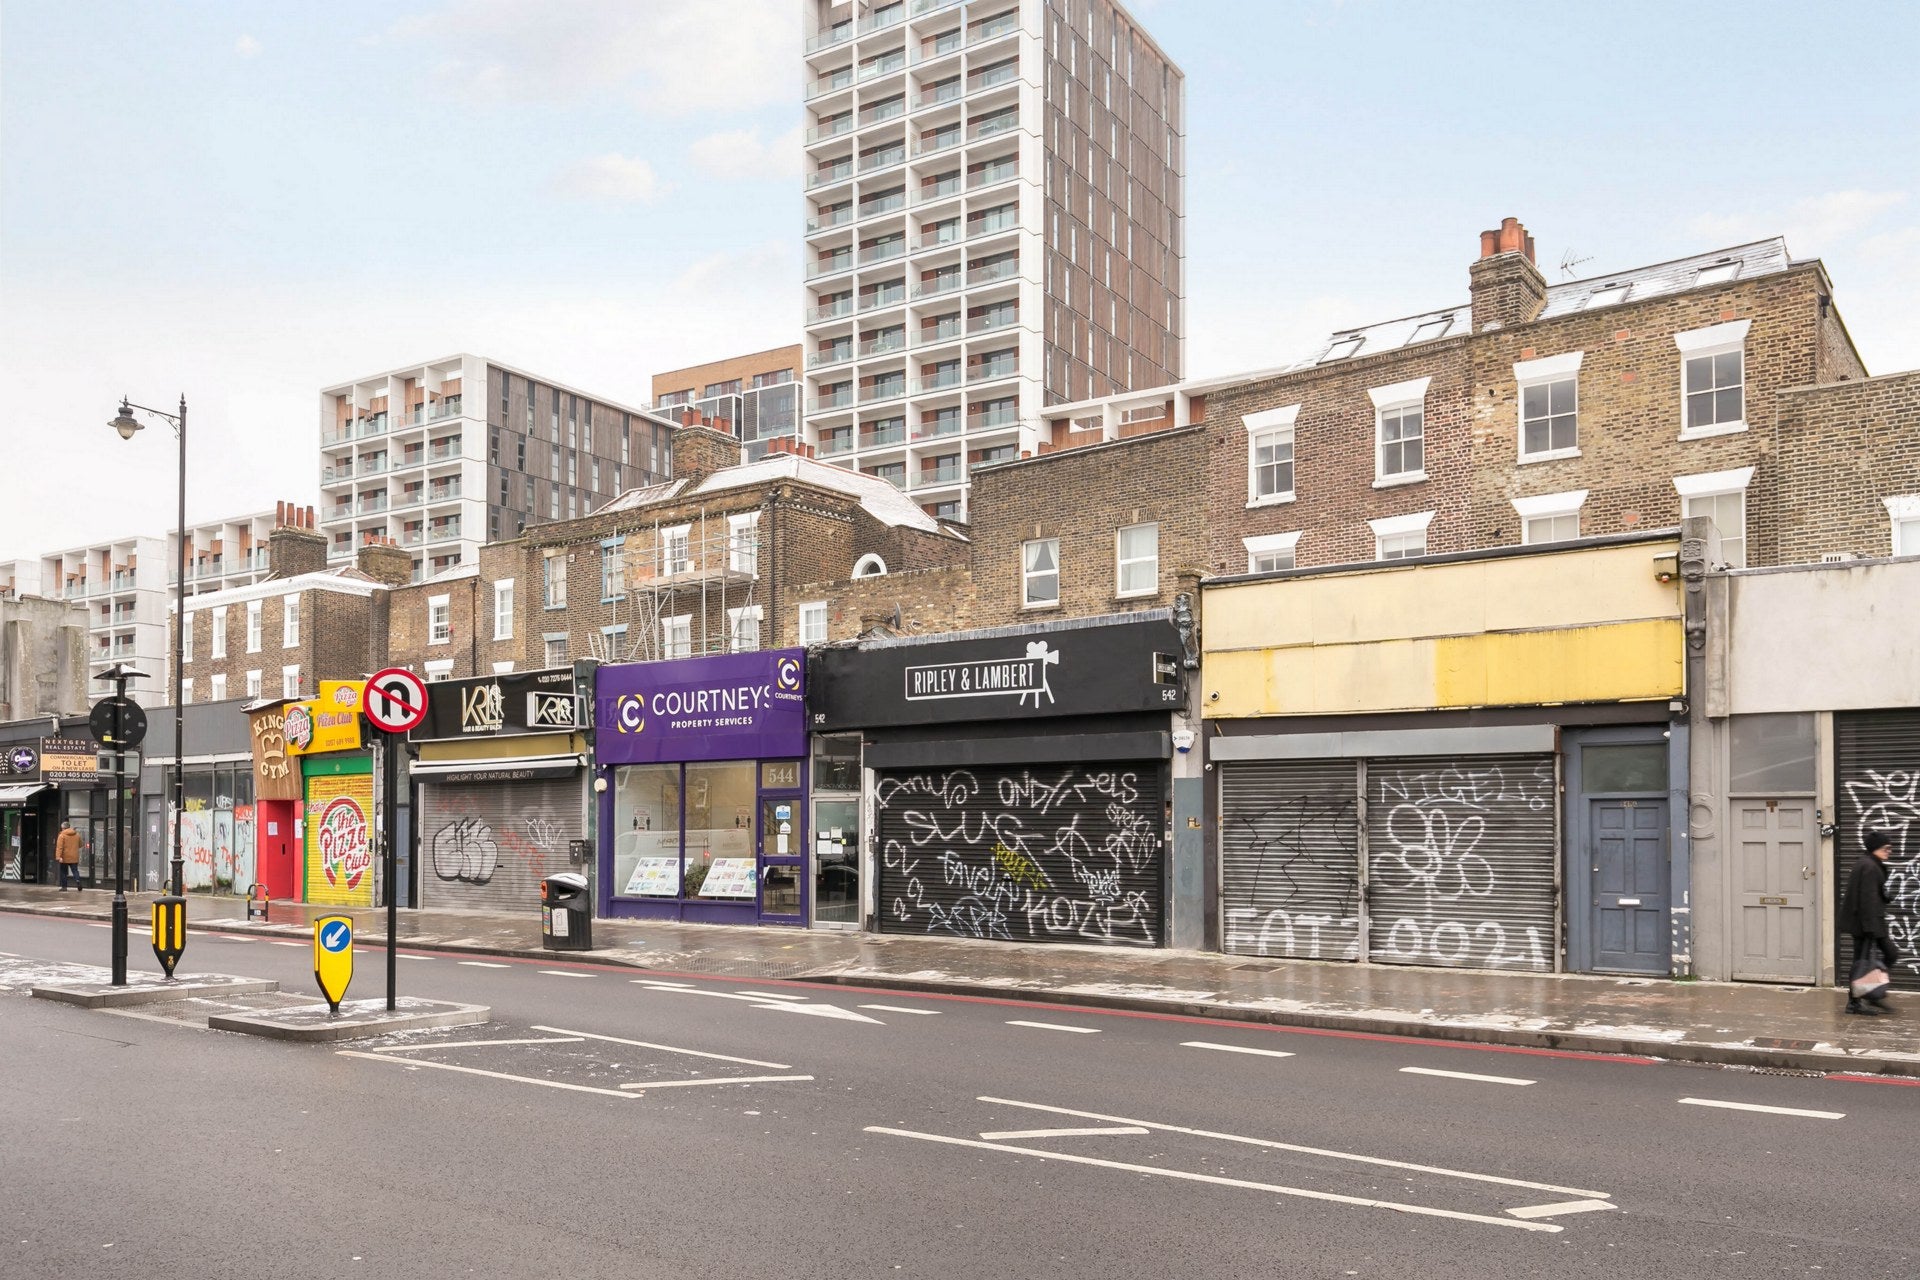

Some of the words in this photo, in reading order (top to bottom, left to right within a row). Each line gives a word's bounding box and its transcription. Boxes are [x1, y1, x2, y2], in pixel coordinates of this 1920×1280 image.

[914, 669, 956, 694] RIPLEY
[960, 667, 970, 691] &
[975, 663, 1035, 689] LAMBERT
[774, 692, 803, 702] COURTNEYS
[1162, 689, 1177, 701] 542
[253, 714, 284, 737] KING
[671, 718, 712, 729] PROPERTY
[715, 716, 753, 727] SERVICES
[814, 713, 826, 724] 542
[285, 717, 309, 740] Pizza
[260, 760, 290, 779] GYM
[446, 772, 473, 781] HIGHLIGHT
[473, 772, 487, 780] YOUR
[488, 771, 511, 779] NATURAL
[512, 770, 534, 779] BEAUTY
[768, 767, 794, 784] 544
[334, 808, 355, 831] The
[319, 825, 367, 865] Pizza
[344, 848, 371, 872] Club
